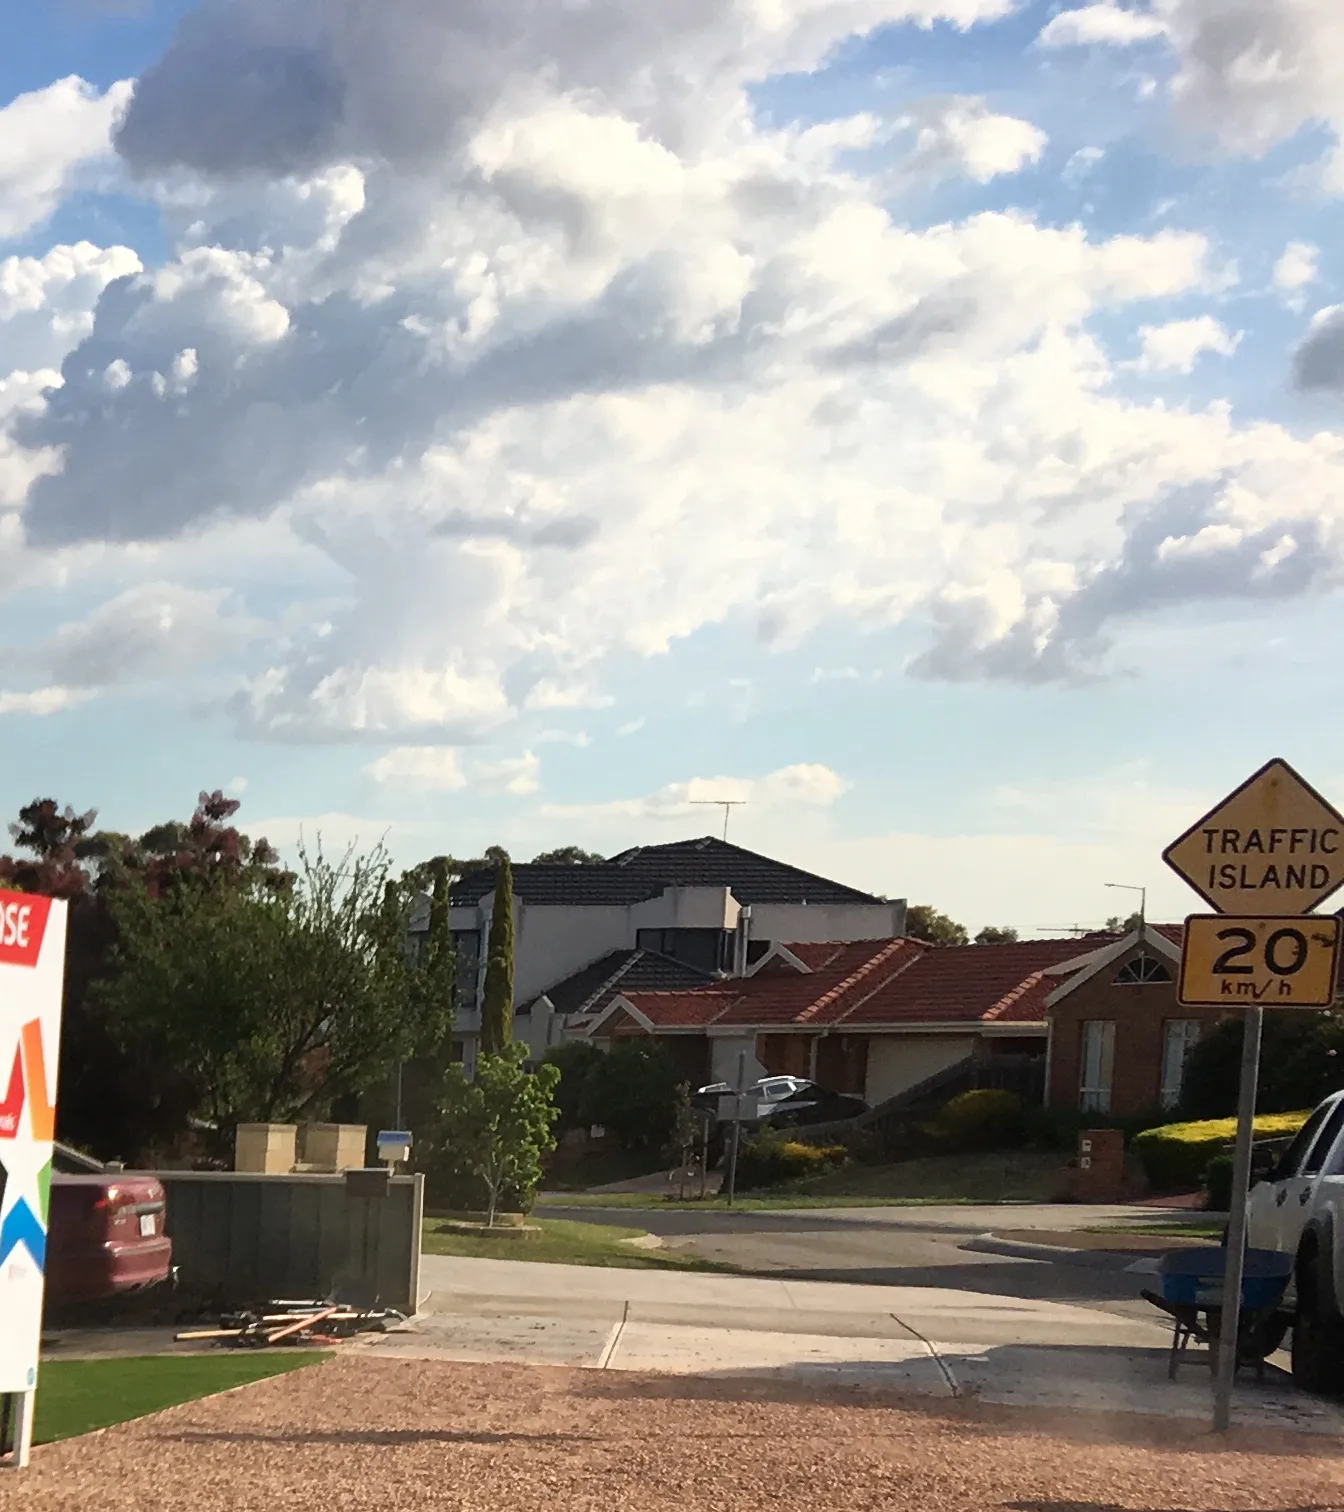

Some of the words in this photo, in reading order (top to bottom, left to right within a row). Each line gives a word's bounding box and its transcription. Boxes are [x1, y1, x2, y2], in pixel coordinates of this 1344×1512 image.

[1202, 828, 1341, 854] TRAFFIC
[1208, 864, 1330, 889] ISLAND
[1212, 927, 1308, 975] 20
[1220, 979, 1292, 998] km/h
